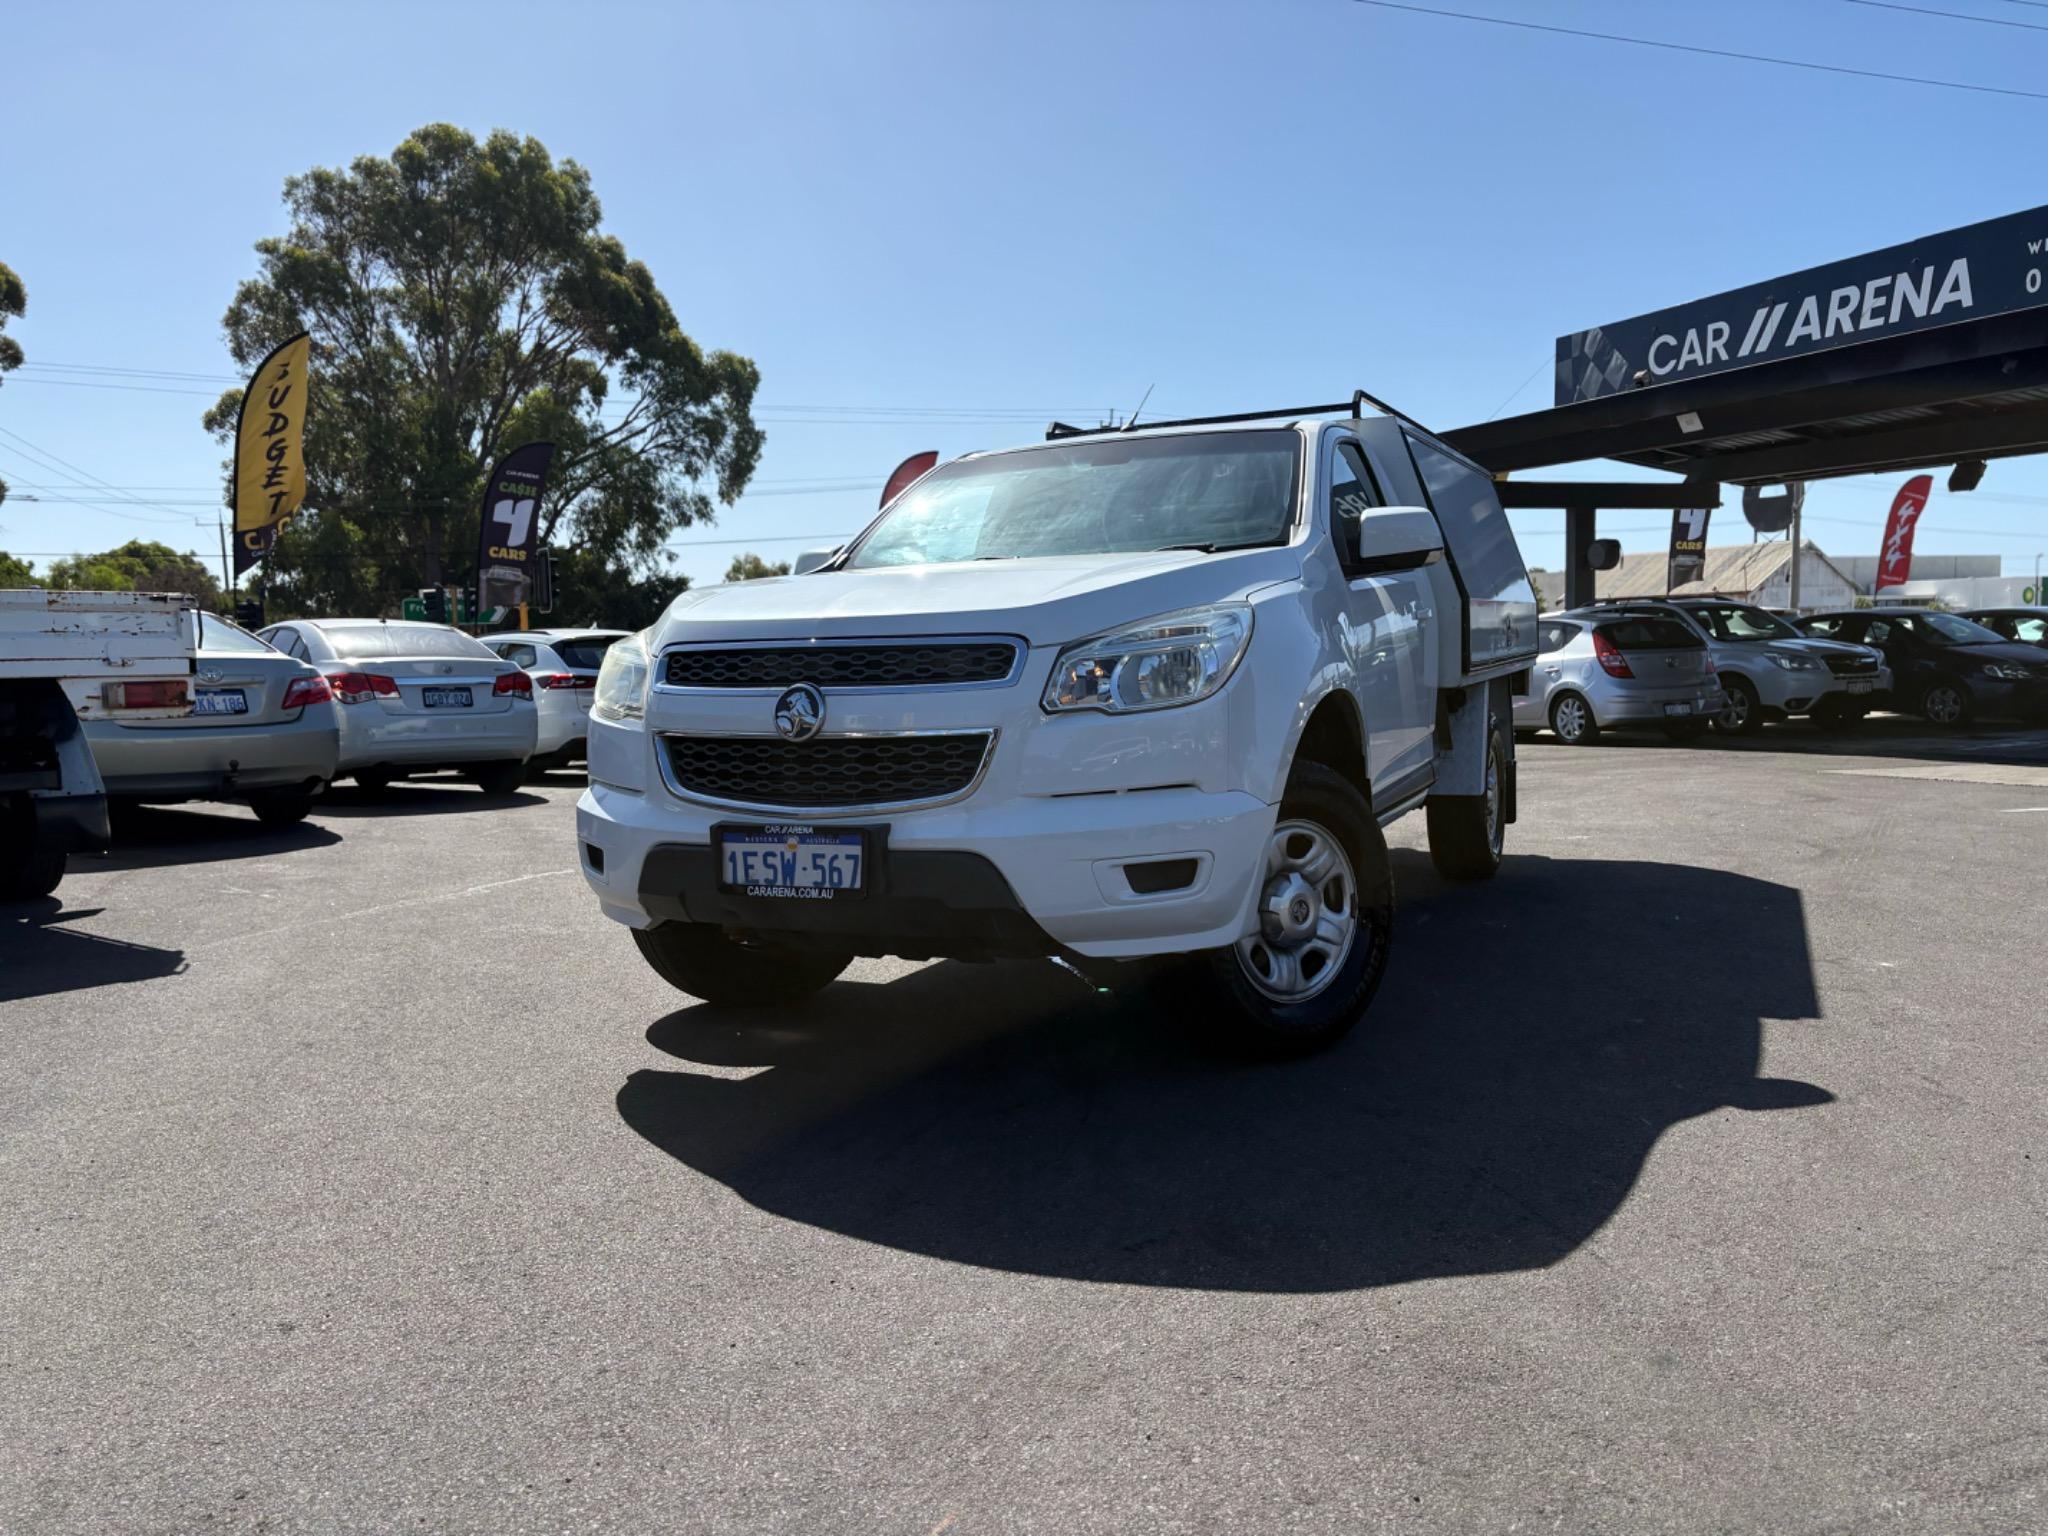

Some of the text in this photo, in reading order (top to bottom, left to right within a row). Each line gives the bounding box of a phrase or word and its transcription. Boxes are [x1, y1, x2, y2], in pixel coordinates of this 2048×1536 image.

[1648, 321, 1730, 376] CAR
[1784, 257, 1974, 347] ARENA
[493, 499, 535, 547] 4
[1675, 541, 1703, 550] CARS
[489, 546, 527, 560] CARS
[747, 886, 834, 899] CARARENA.COM.AU
